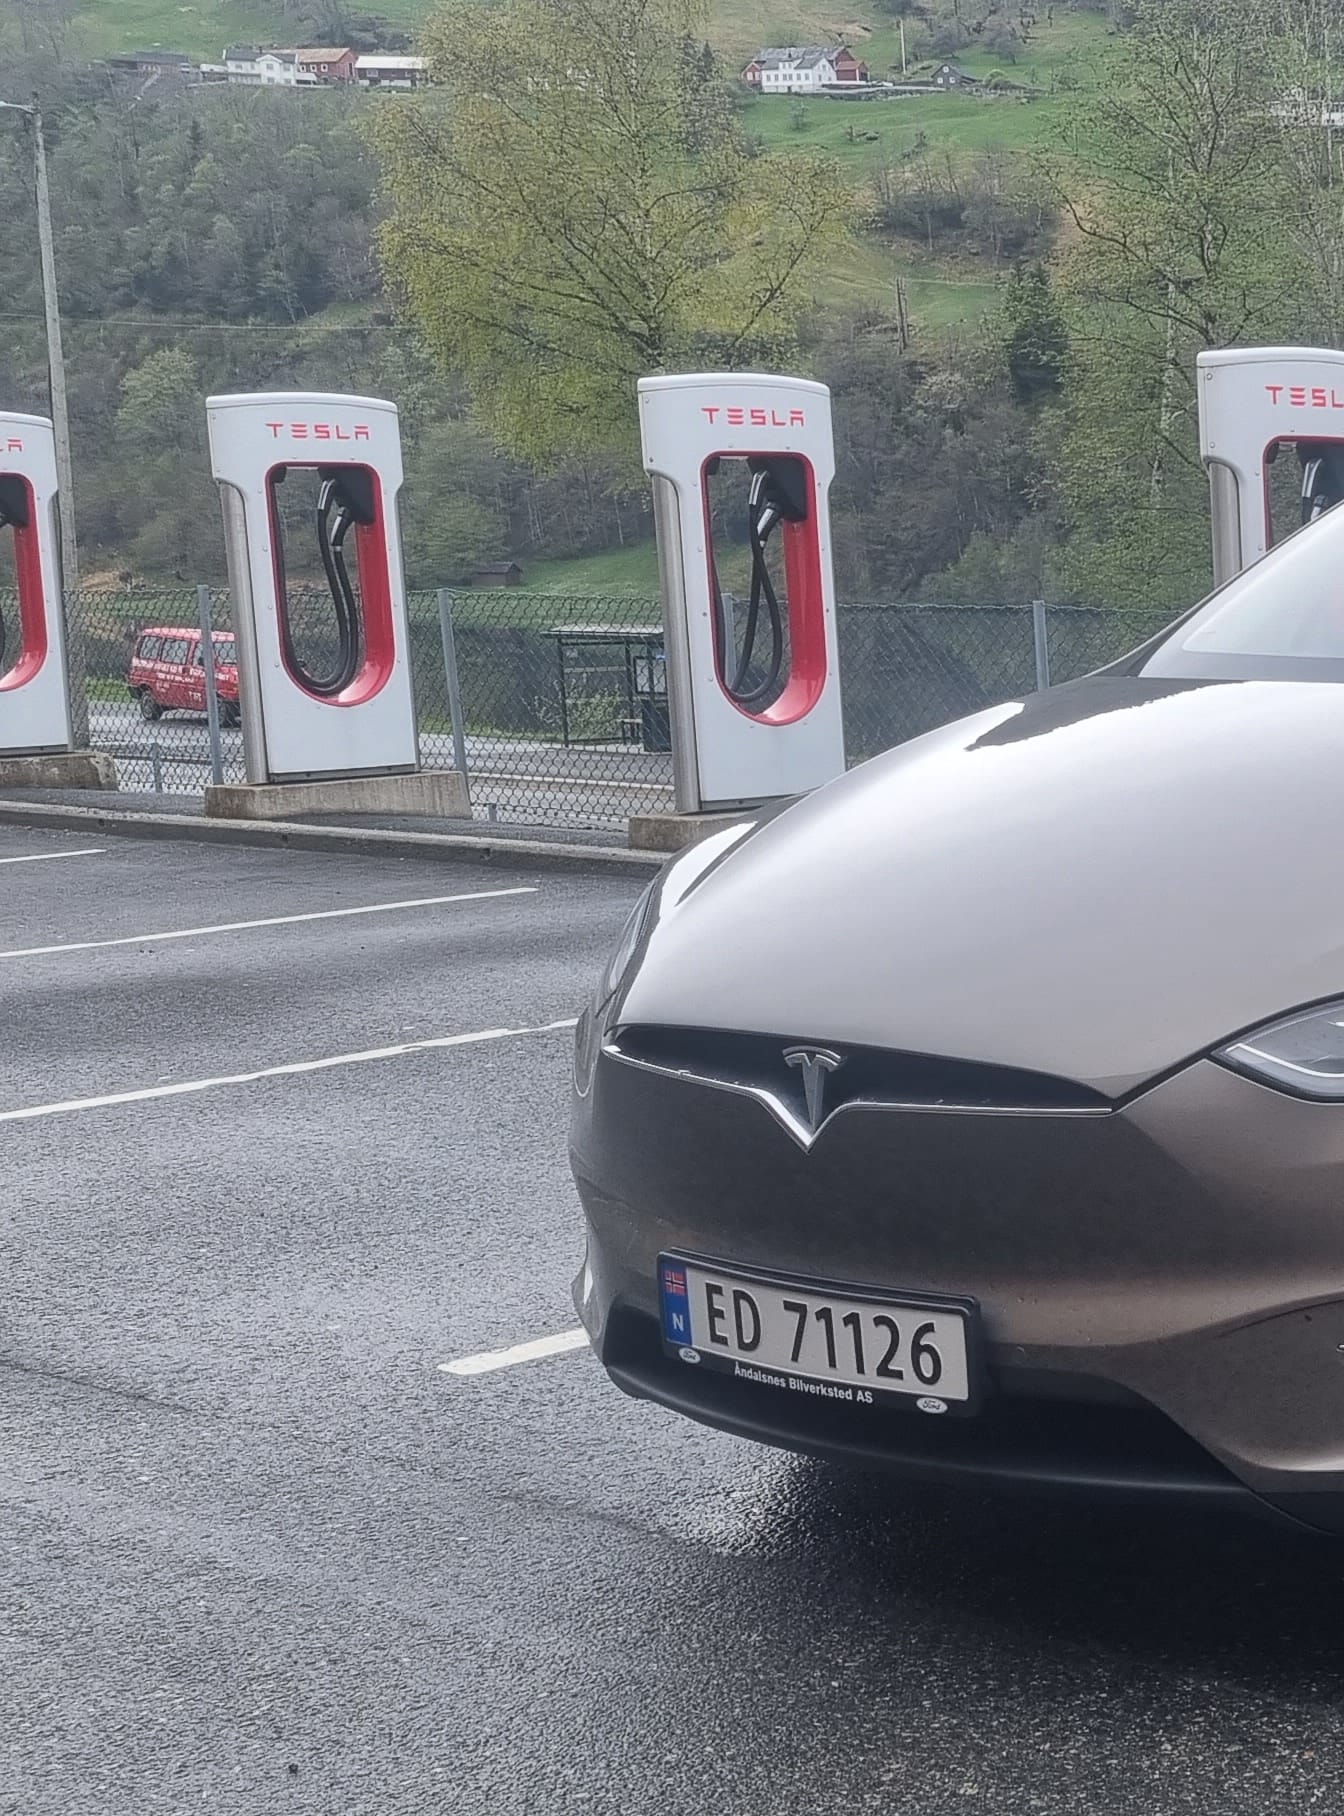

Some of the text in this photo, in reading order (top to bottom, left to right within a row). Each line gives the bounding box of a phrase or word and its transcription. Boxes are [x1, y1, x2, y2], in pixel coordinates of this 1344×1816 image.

[701, 407, 805, 427] TESLA
[265, 423, 370, 440] TESLA
[672, 1312, 685, 1332] N
[705, 1282, 942, 1386] ED 71126
[734, 1361, 873, 1404] Åndalsnes Bilverksted AS
